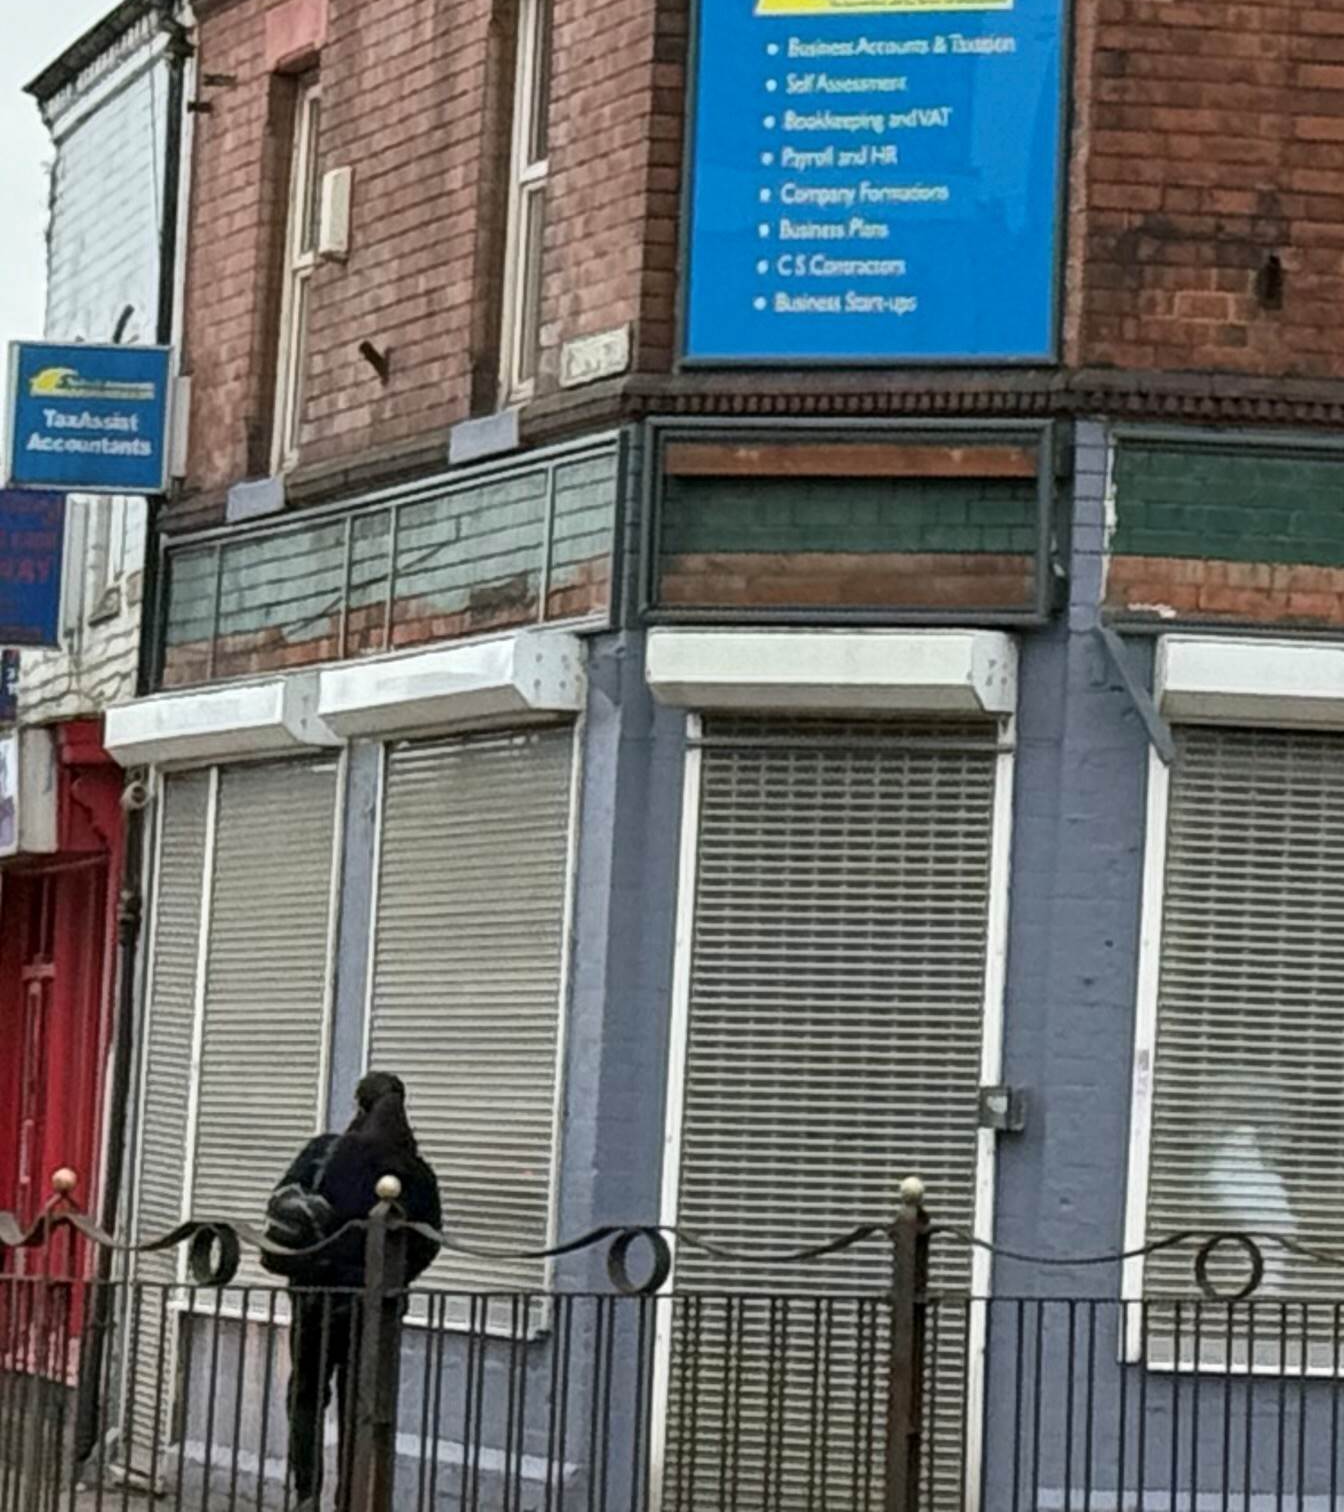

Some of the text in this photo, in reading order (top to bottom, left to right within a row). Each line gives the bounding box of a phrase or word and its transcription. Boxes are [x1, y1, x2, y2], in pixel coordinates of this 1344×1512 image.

[788, 33, 1015, 57] Business Accounts & Taxation
[786, 73, 907, 94] Self Assessment
[785, 106, 953, 134] Bookkeeping and VAT
[781, 144, 898, 171] Payroll and HR
[780, 180, 949, 207] Company Formations
[779, 216, 889, 240] Business Plans
[774, 290, 917, 316] Business Start-ups
[43, 408, 139, 432] TaxAssist
[26, 432, 152, 456] Accountants
